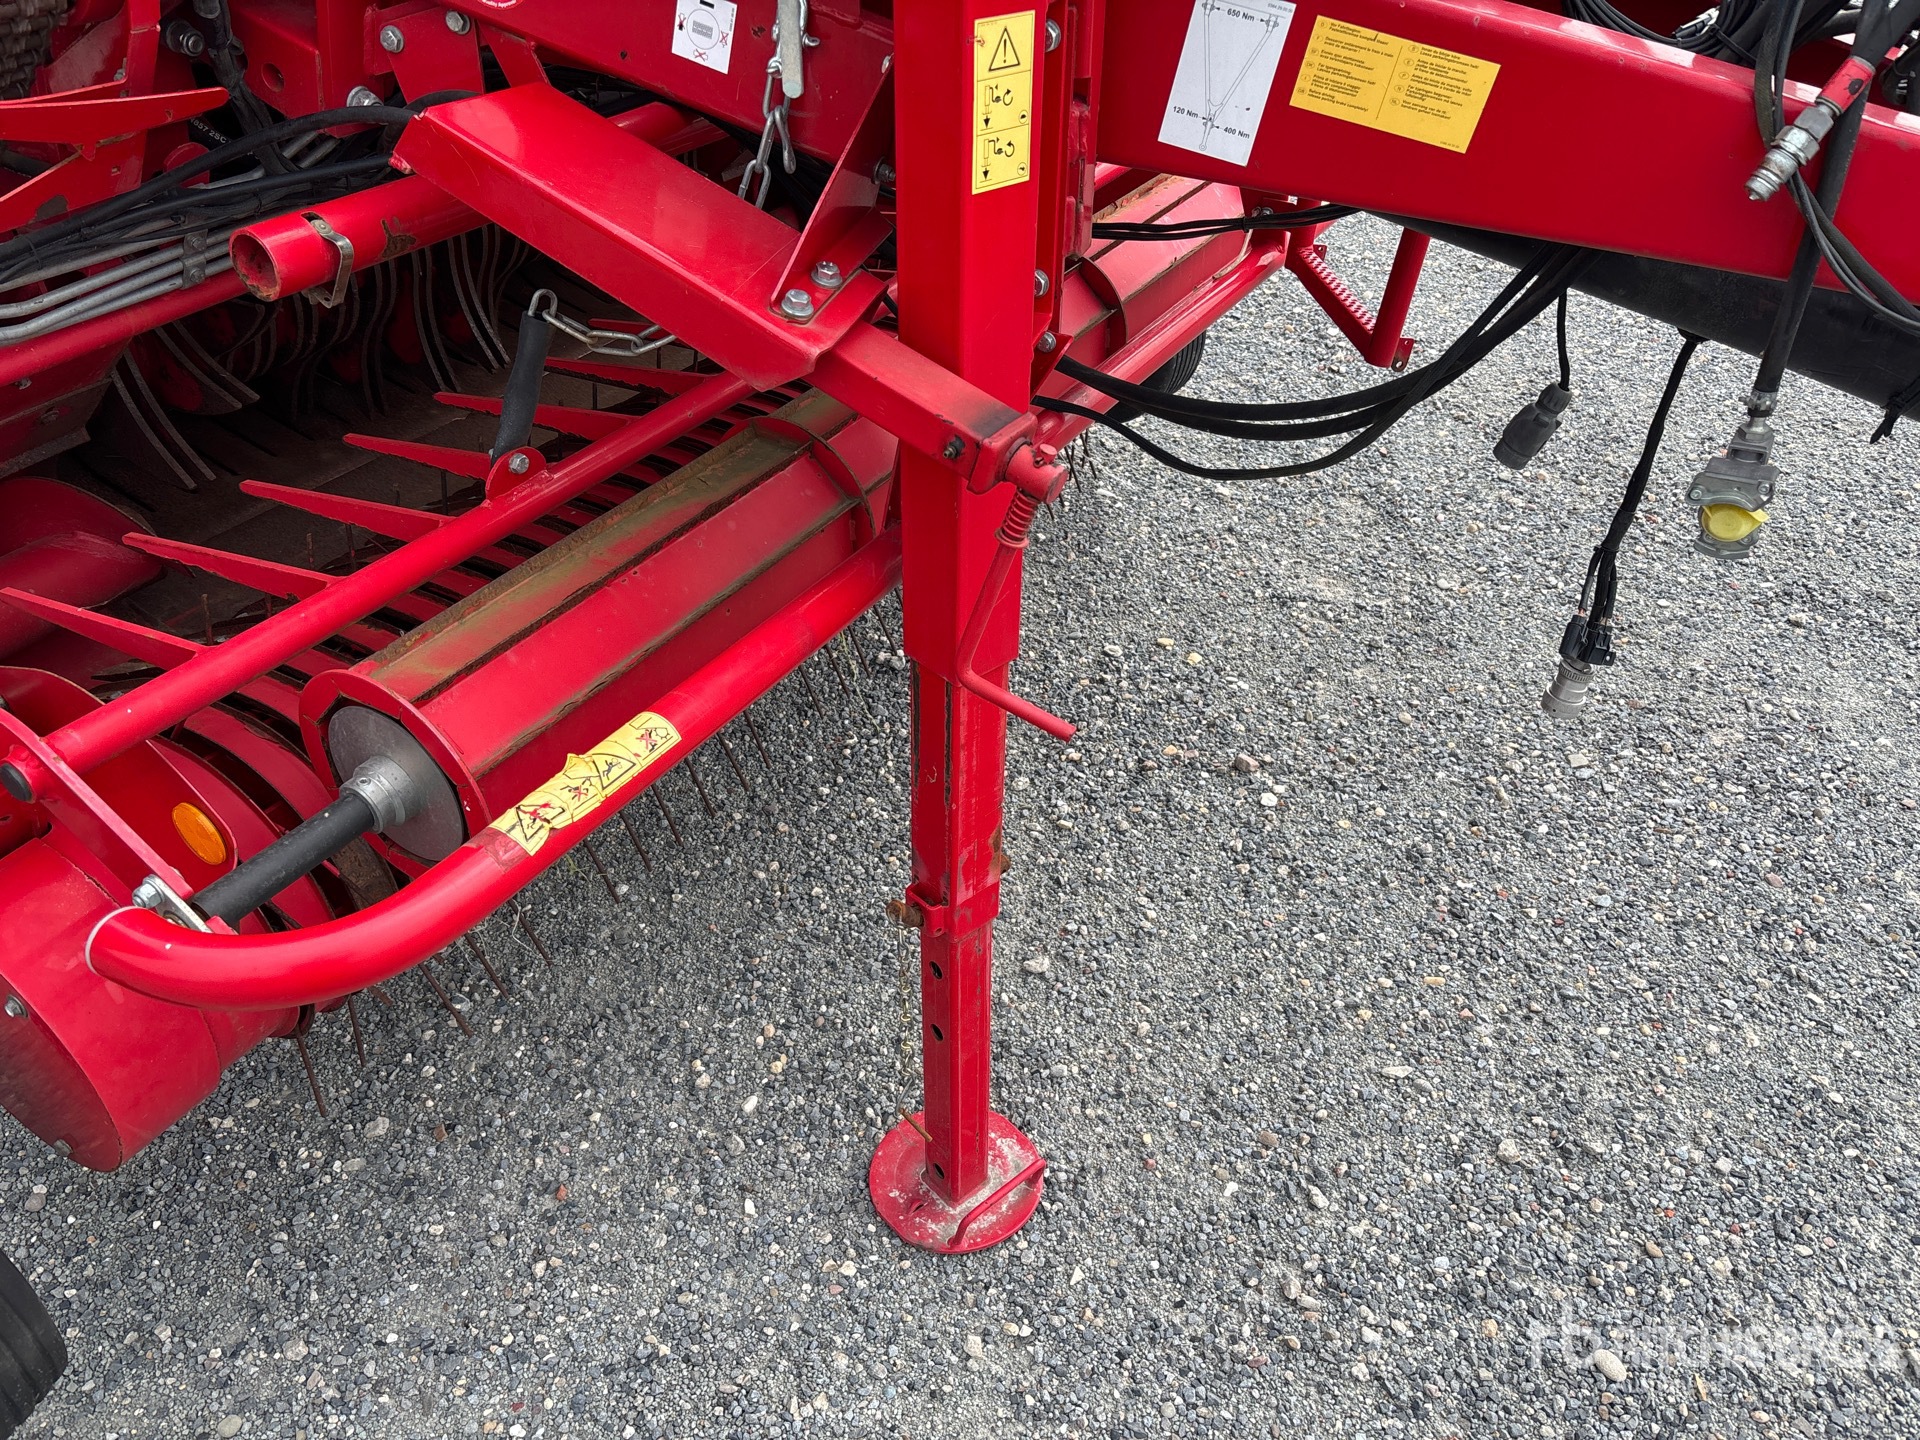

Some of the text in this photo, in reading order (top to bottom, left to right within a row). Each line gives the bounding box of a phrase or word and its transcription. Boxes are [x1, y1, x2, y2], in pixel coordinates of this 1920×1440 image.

[1227, 9, 1255, 22] 650 Nm
[1173, 106, 1199, 119] 120 Nm
[209, 130, 227, 143] 2SC
[1224, 126, 1250, 139] 400 Nm
